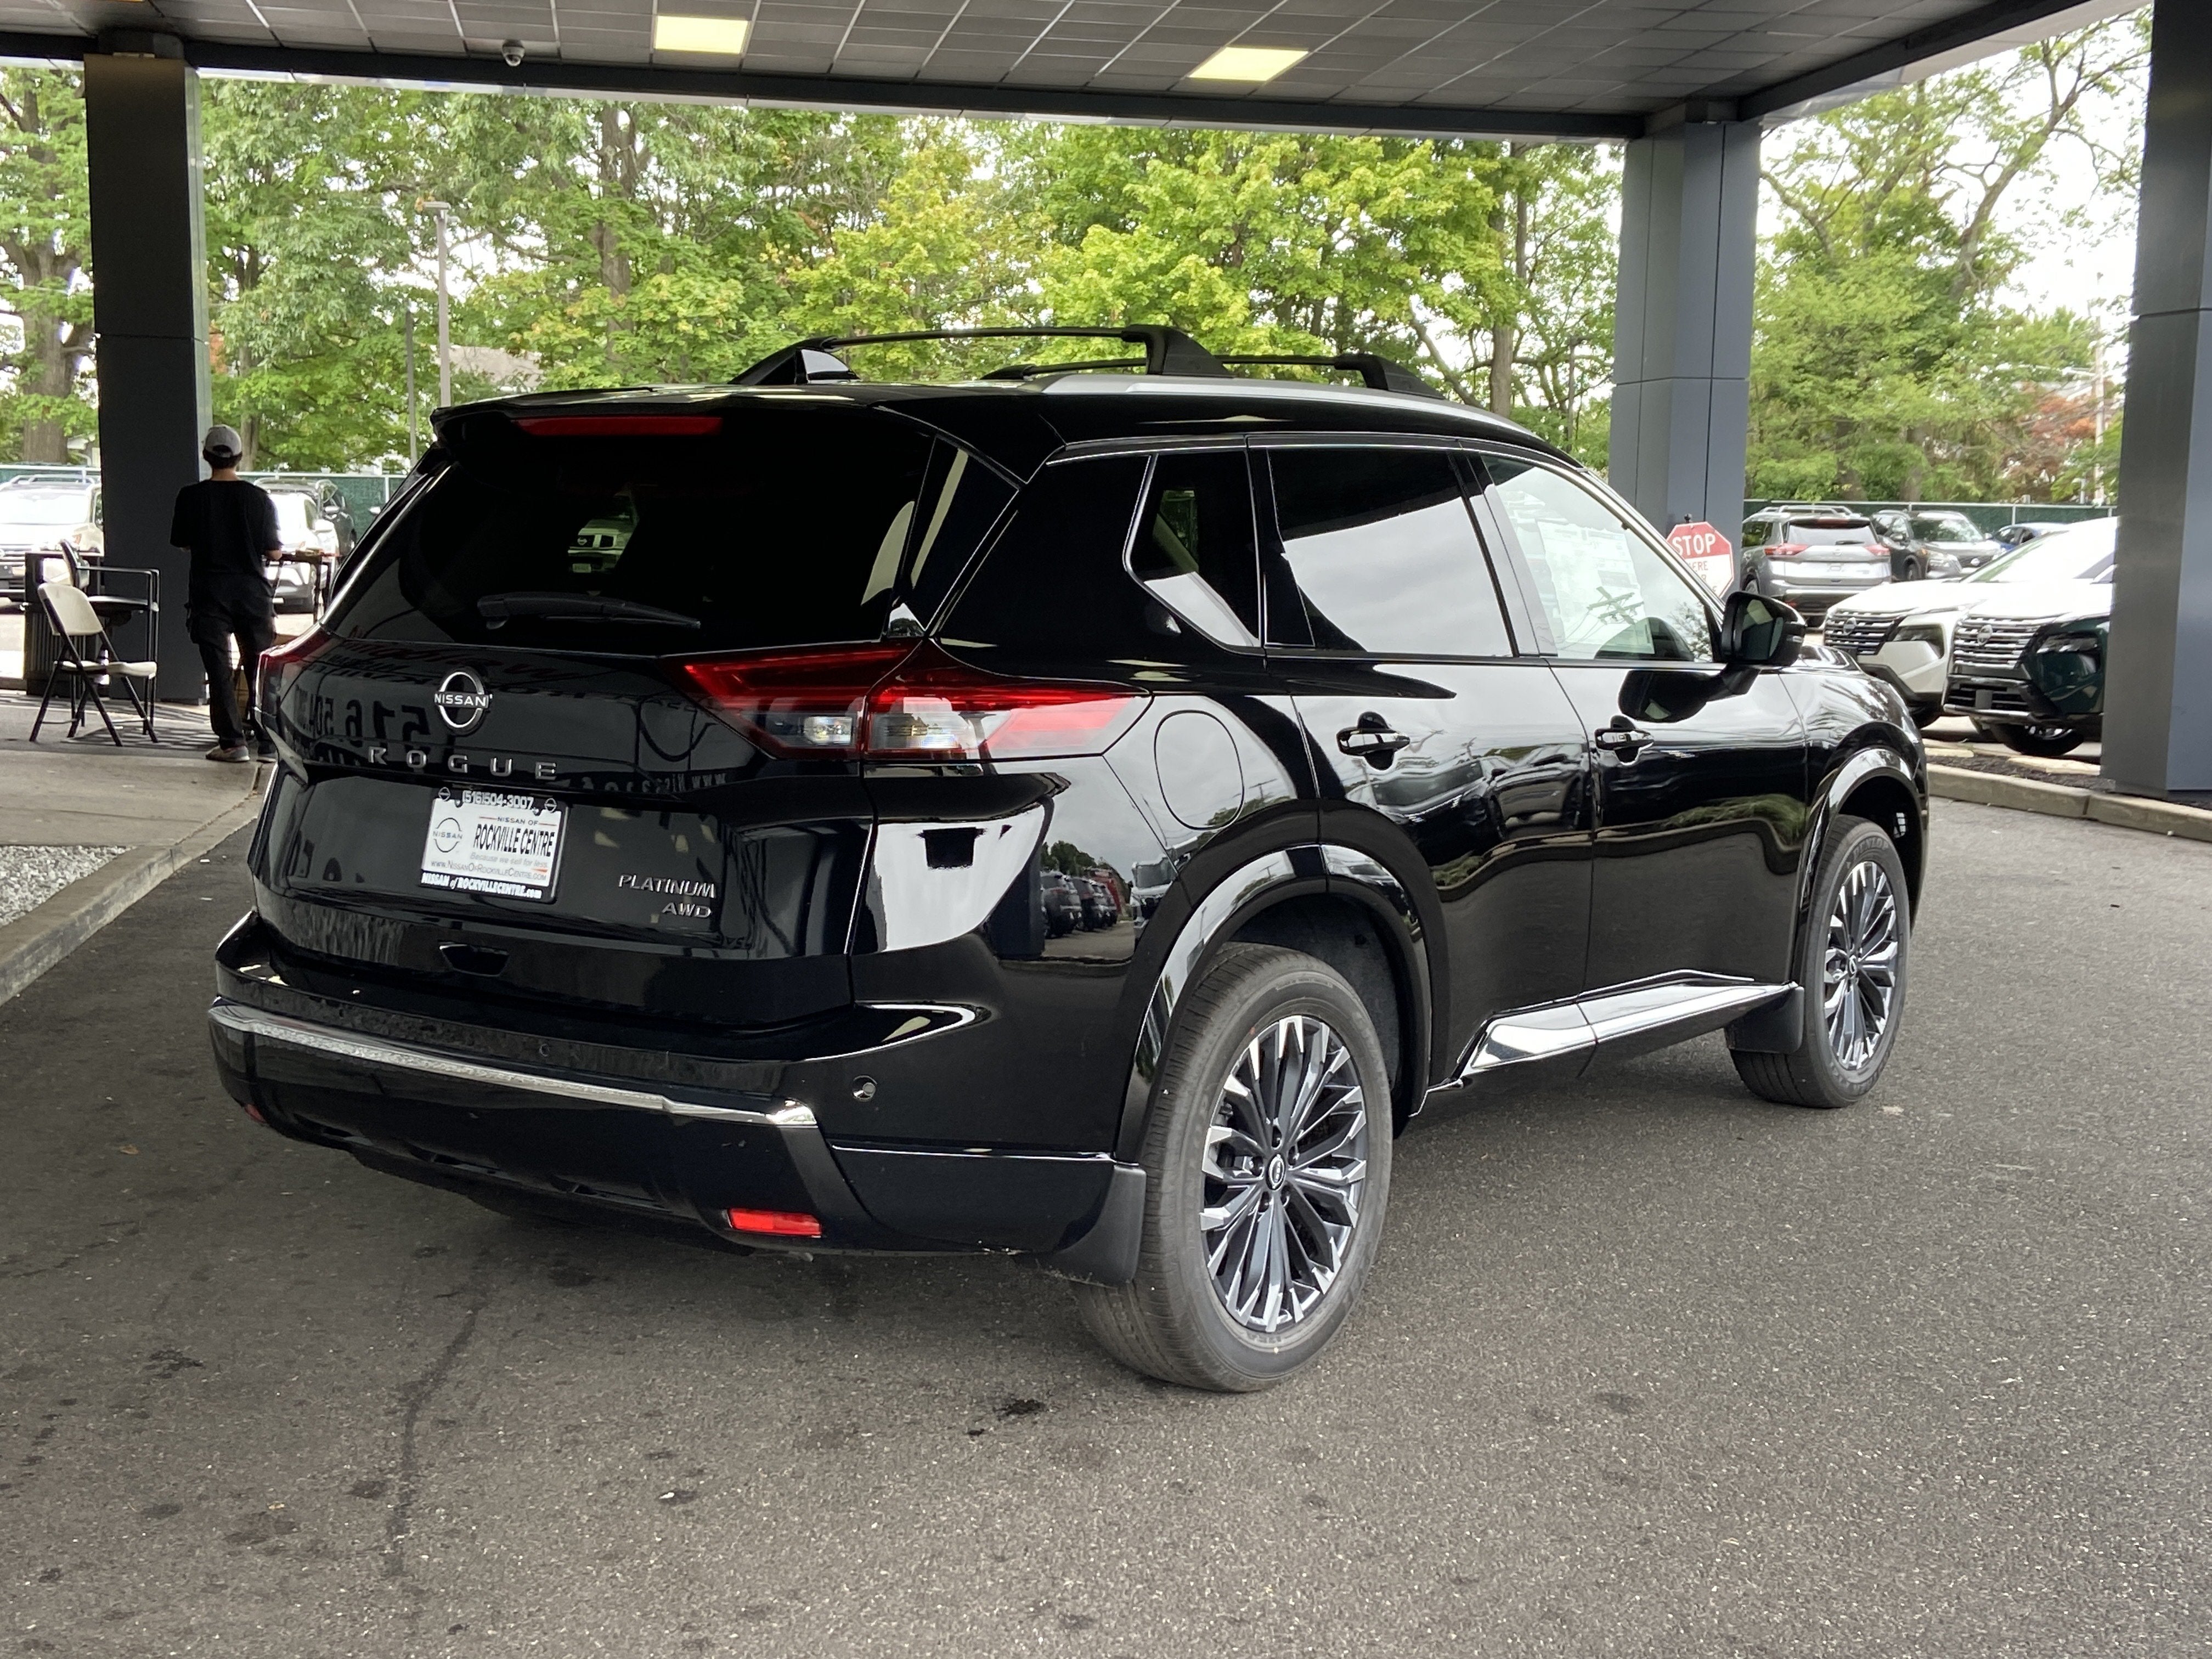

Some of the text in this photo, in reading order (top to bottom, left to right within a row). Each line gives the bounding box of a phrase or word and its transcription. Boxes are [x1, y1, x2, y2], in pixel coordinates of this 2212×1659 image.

[1672, 533, 1716, 556] STOP
[1688, 561, 1709, 571] ERE
[434, 692, 488, 708] NISSAN
[368, 746, 557, 781] ROGUE
[497, 816, 525, 825] NISSAN
[432, 831, 462, 840] NISSAN
[473, 823, 555, 857] ROCKVILLE CENTRE
[470, 852, 498, 863] Because
[421, 872, 450, 887] NISSAN
[450, 878, 459, 889] of
[618, 874, 716, 898] PLATINUM
[662, 902, 712, 918] AWD
